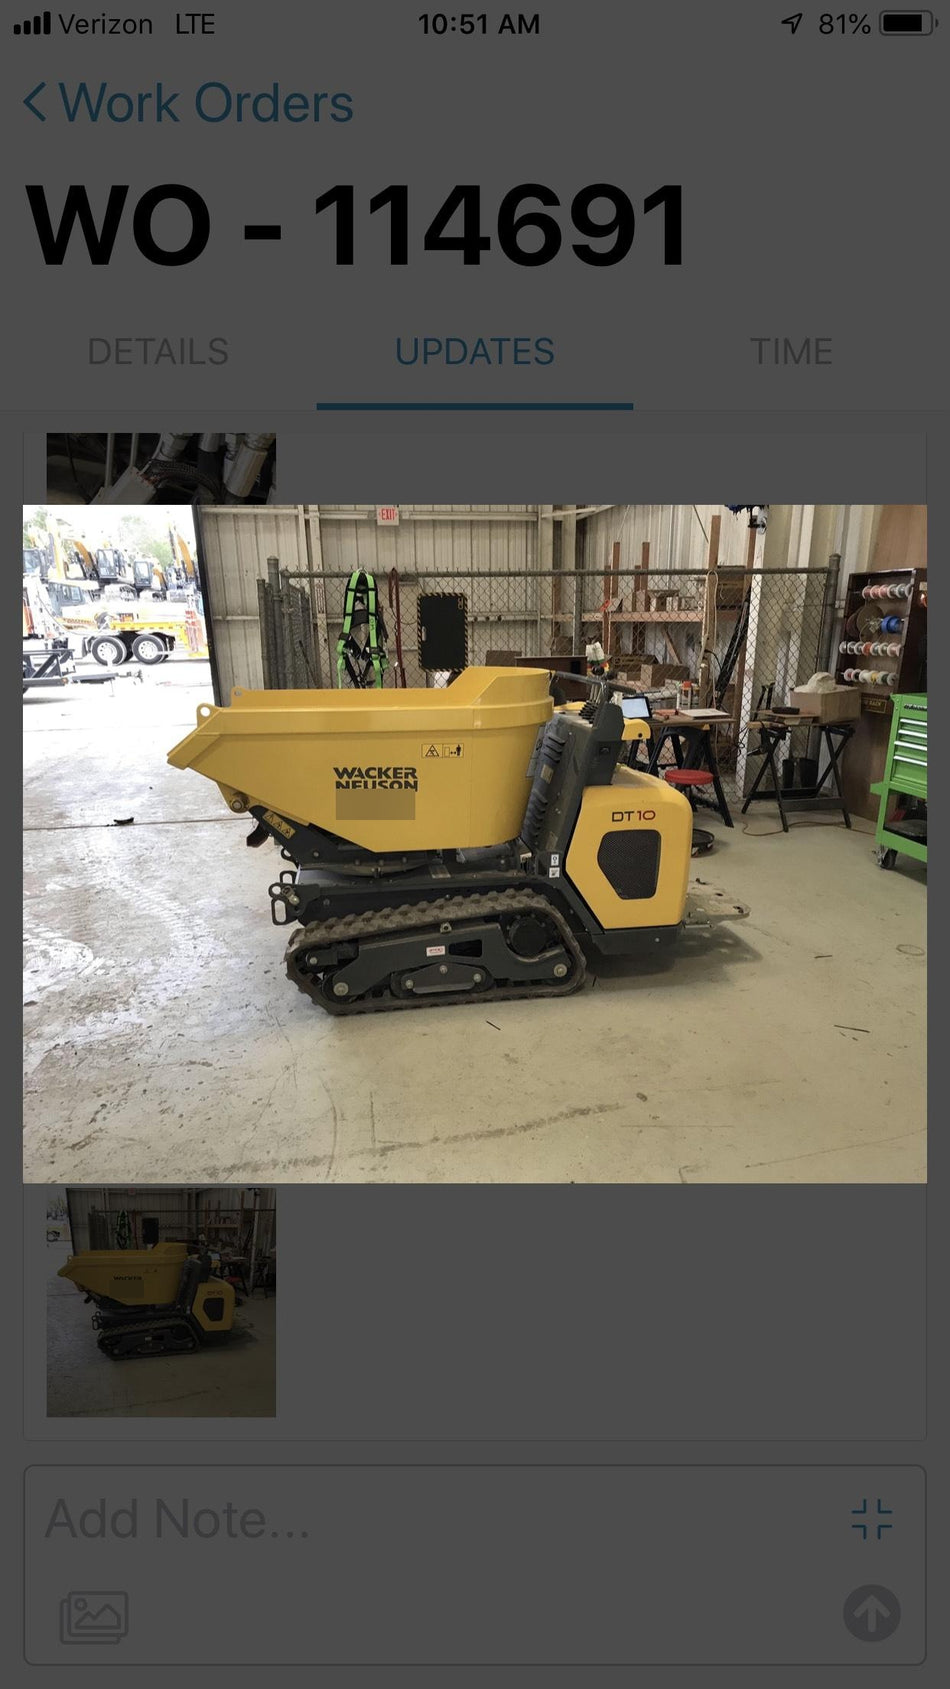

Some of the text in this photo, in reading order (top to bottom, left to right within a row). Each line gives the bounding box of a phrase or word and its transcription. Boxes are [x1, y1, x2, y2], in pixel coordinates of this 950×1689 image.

[381, 508, 396, 520] EXIT
[333, 767, 418, 779] WACKER
[612, 810, 656, 822] DT10
